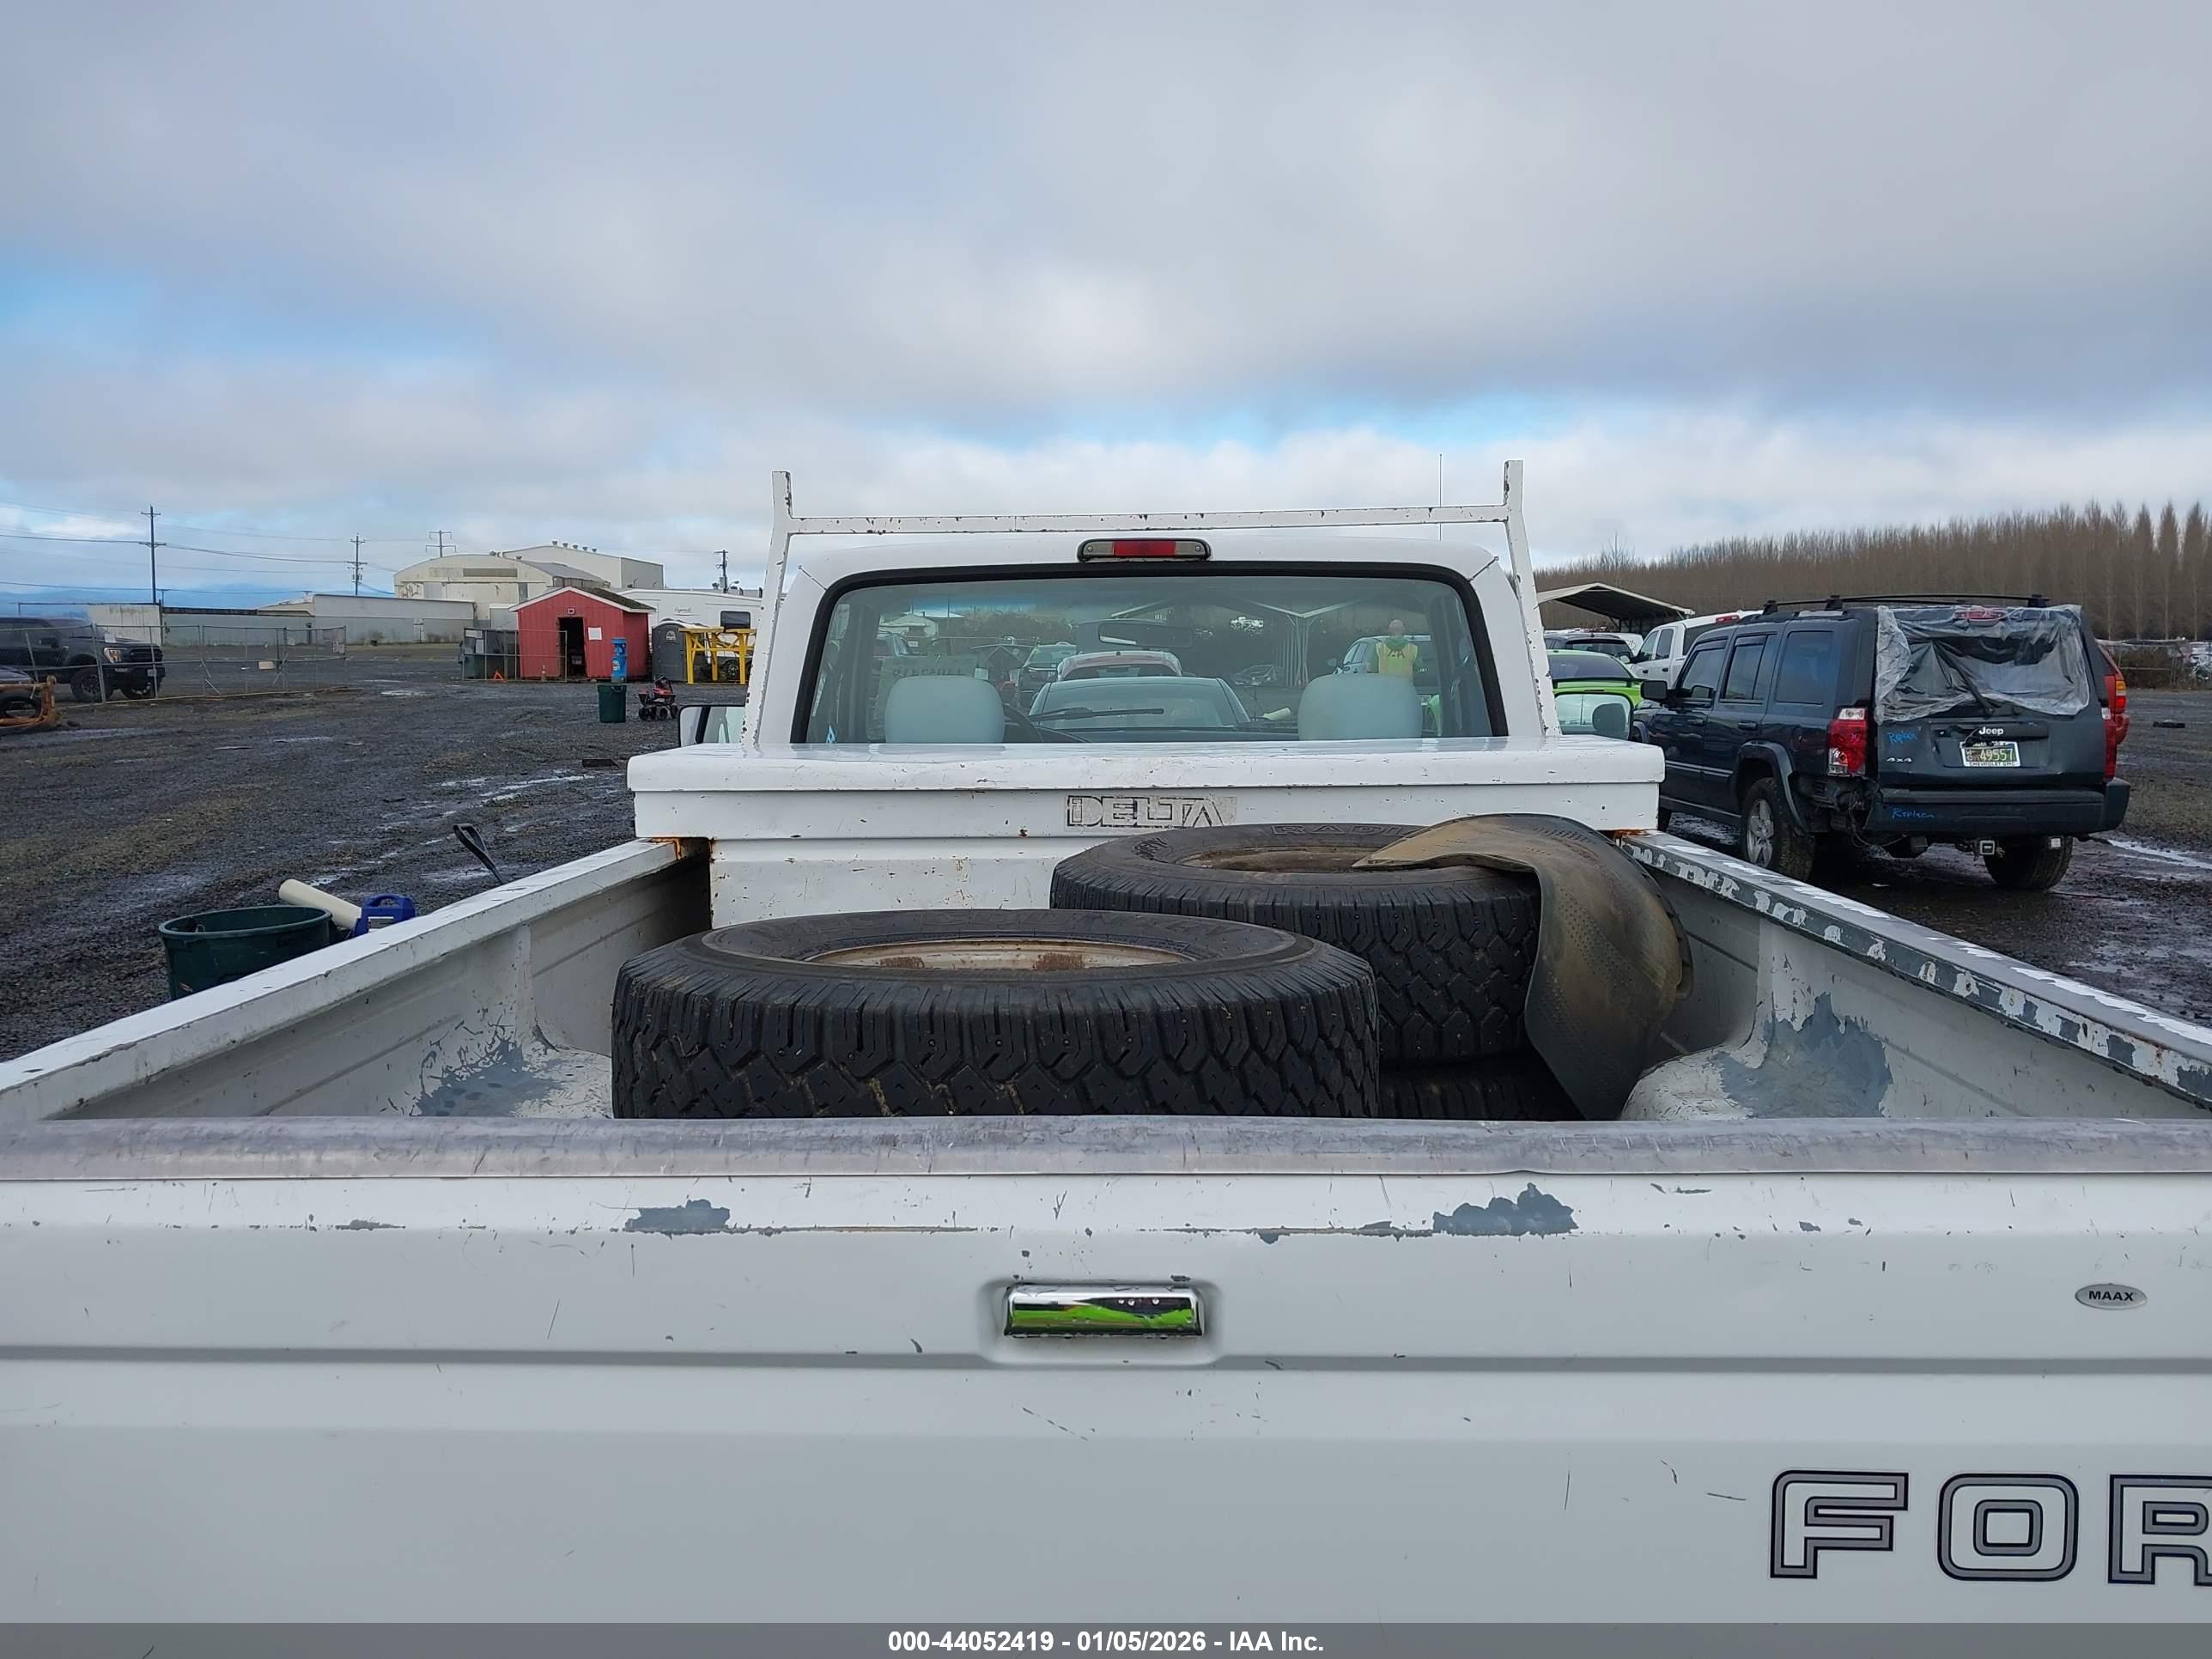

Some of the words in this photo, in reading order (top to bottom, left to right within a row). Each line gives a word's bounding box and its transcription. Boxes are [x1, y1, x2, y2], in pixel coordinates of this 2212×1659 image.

[1978, 726, 2004, 736] Jeep
[1980, 749, 2013, 761] 49557
[1066, 794, 1224, 829] DELTA
[1271, 824, 1417, 837] RADI
[2088, 1291, 2134, 1301] MAAX
